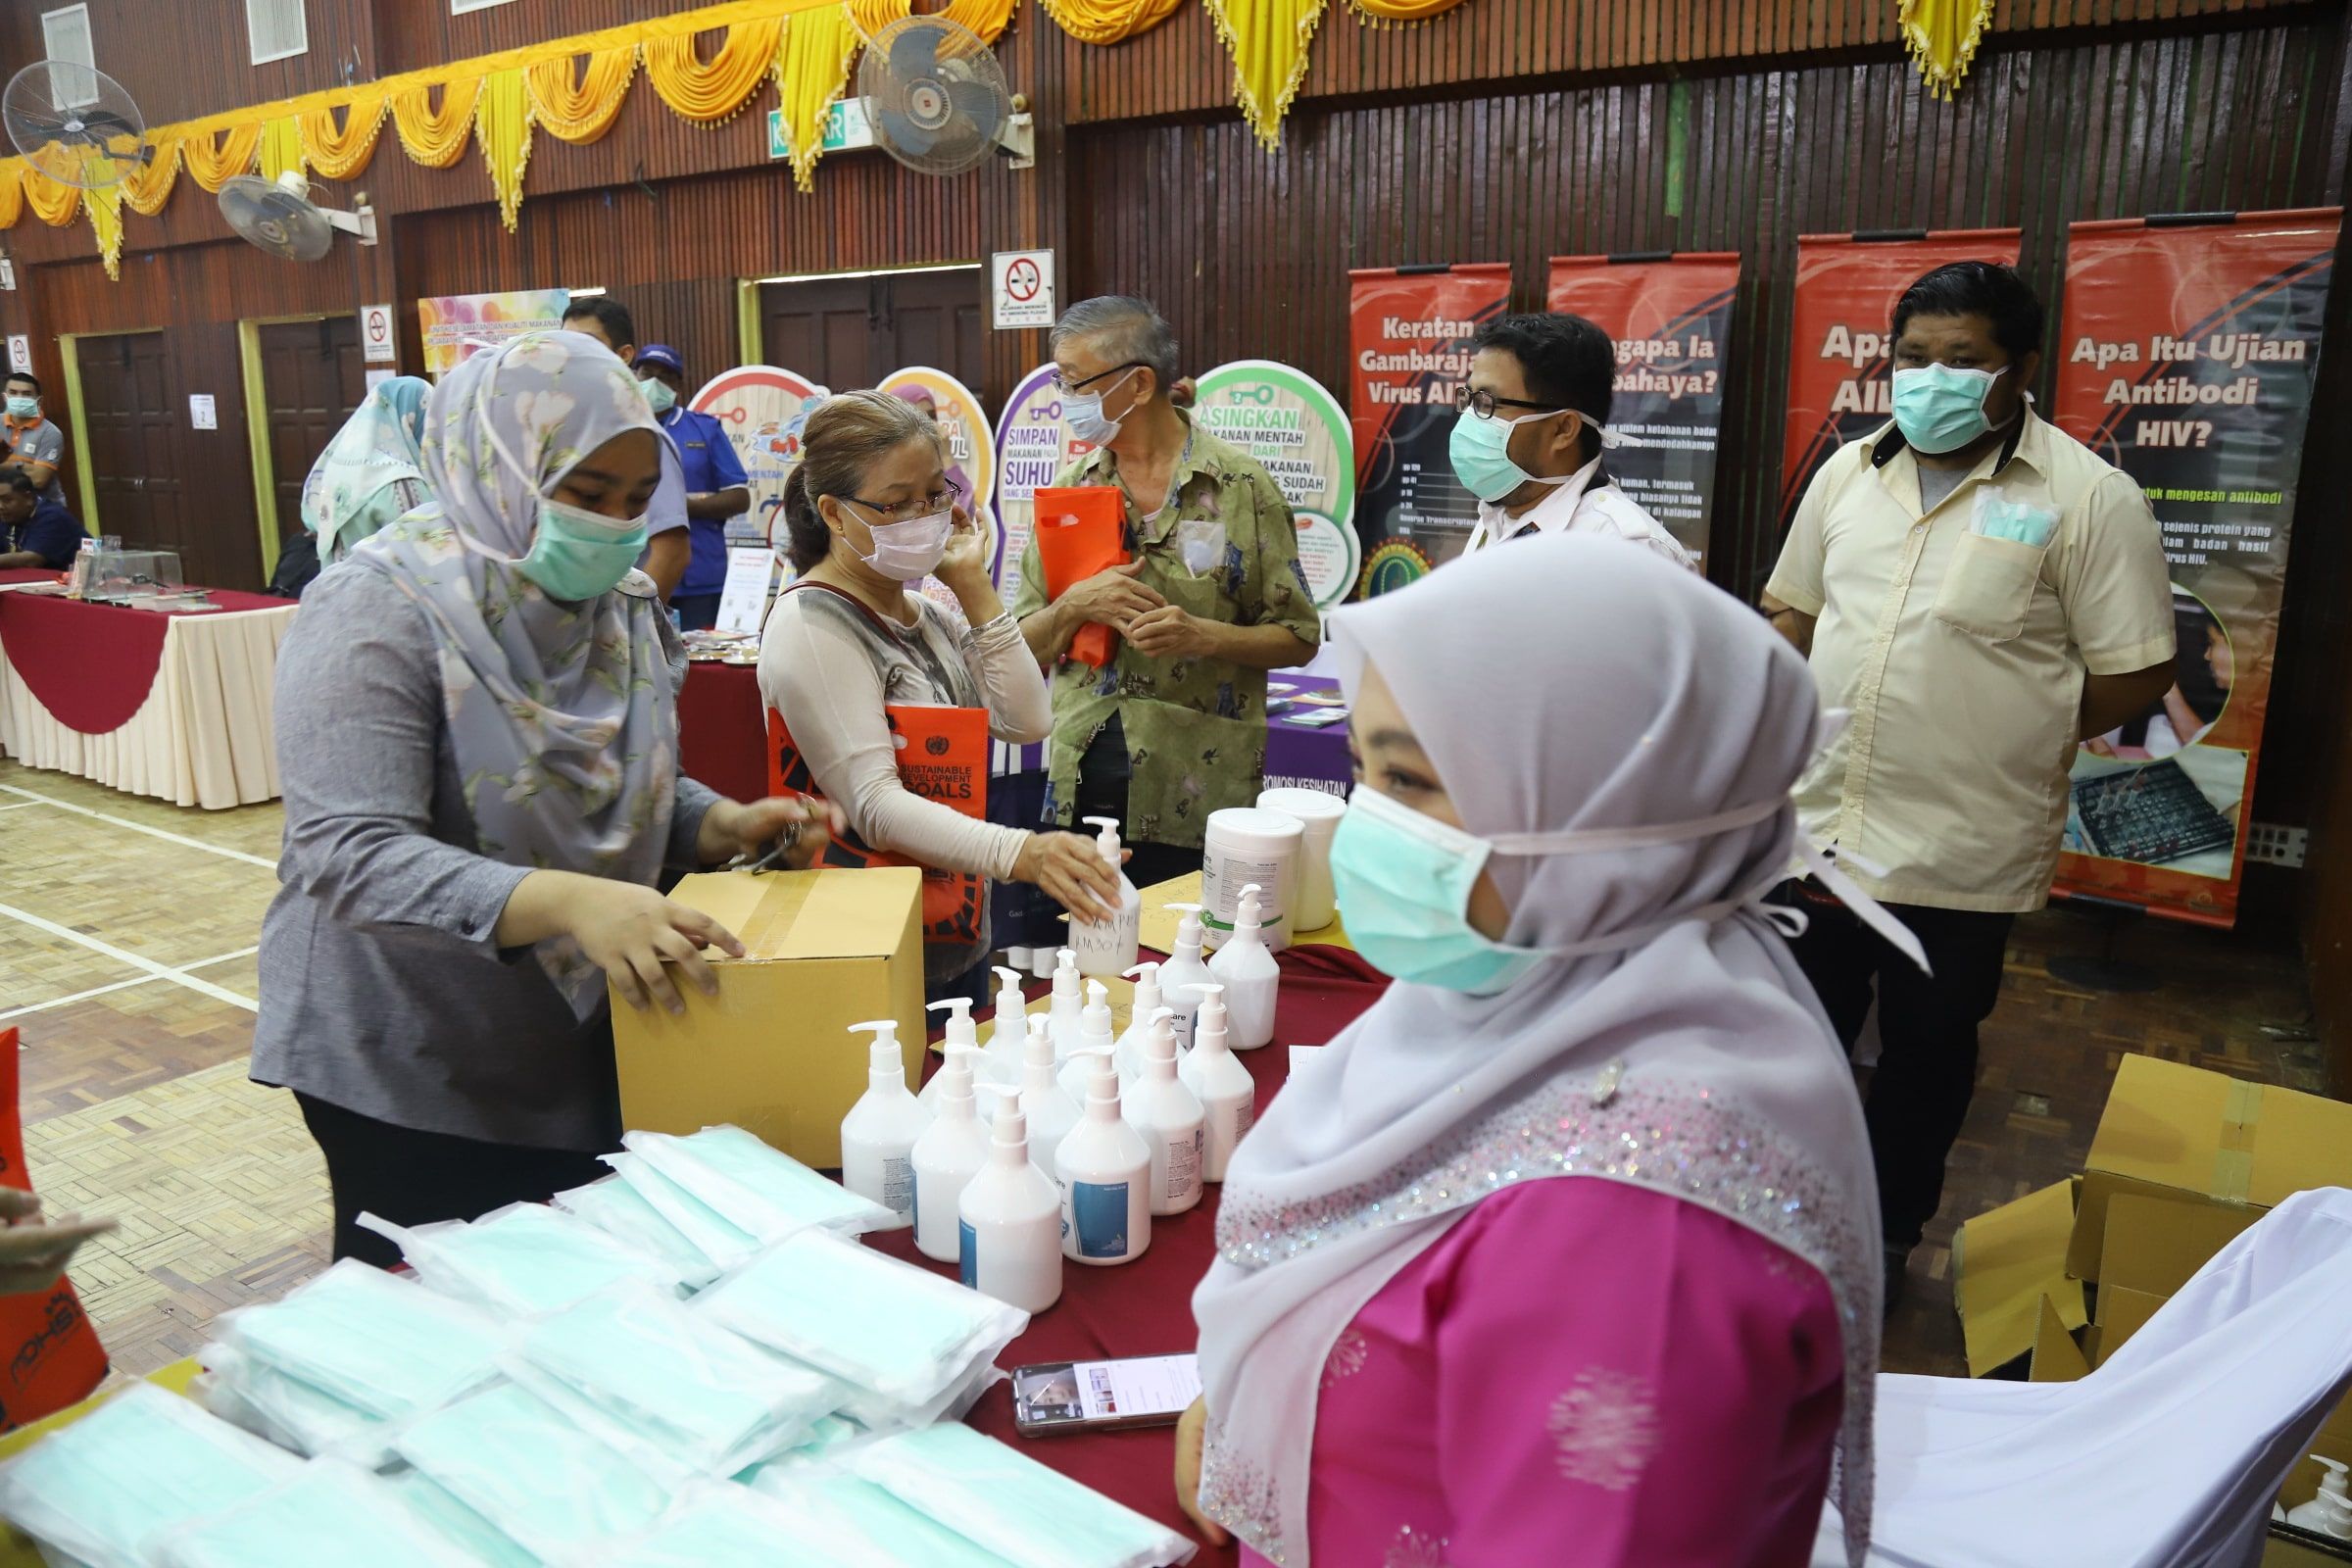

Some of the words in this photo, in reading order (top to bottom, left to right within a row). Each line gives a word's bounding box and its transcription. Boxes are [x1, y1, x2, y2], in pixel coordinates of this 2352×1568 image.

[1383, 317, 1475, 339] Keratan
[2071, 337, 2139, 370] Apa
[2150, 336, 2197, 362] Itu
[2209, 333, 2306, 369] Ujian
[1368, 381, 1422, 404] Virus
[2103, 377, 2258, 405] Antibodi
[1235, 393, 1242, 404] 2
[1200, 408, 1298, 429] ASINGKAN
[1007, 428, 1058, 445] SIMPAN
[1618, 423, 1645, 434] sistem
[1646, 424, 1692, 436] ketahanan
[2136, 420, 2213, 447] HIV?
[1254, 430, 1303, 444] MENTAH
[1007, 449, 1043, 458] MAKANAN
[1252, 445, 1281, 458] DARI
[1005, 461, 1054, 486] SUHU
[1260, 461, 1311, 473] AKANAN
[1283, 476, 1324, 490] SUDAH
[1652, 479, 1694, 491] termasuk
[1641, 492, 1679, 504] biasanya
[2166, 489, 2227, 503] mengesan
[2230, 491, 2282, 504] antibodi
[1663, 508, 1702, 518] kalangan
[2164, 521, 2200, 534] sejenis
[2202, 523, 2242, 536] protein
[2244, 526, 2272, 538] yang
[2193, 538, 2229, 551] badan
[2238, 541, 2270, 553] hasil
[901, 765, 972, 775] SUSTAINABLE
[901, 774, 972, 783] DEVELOPMENT
